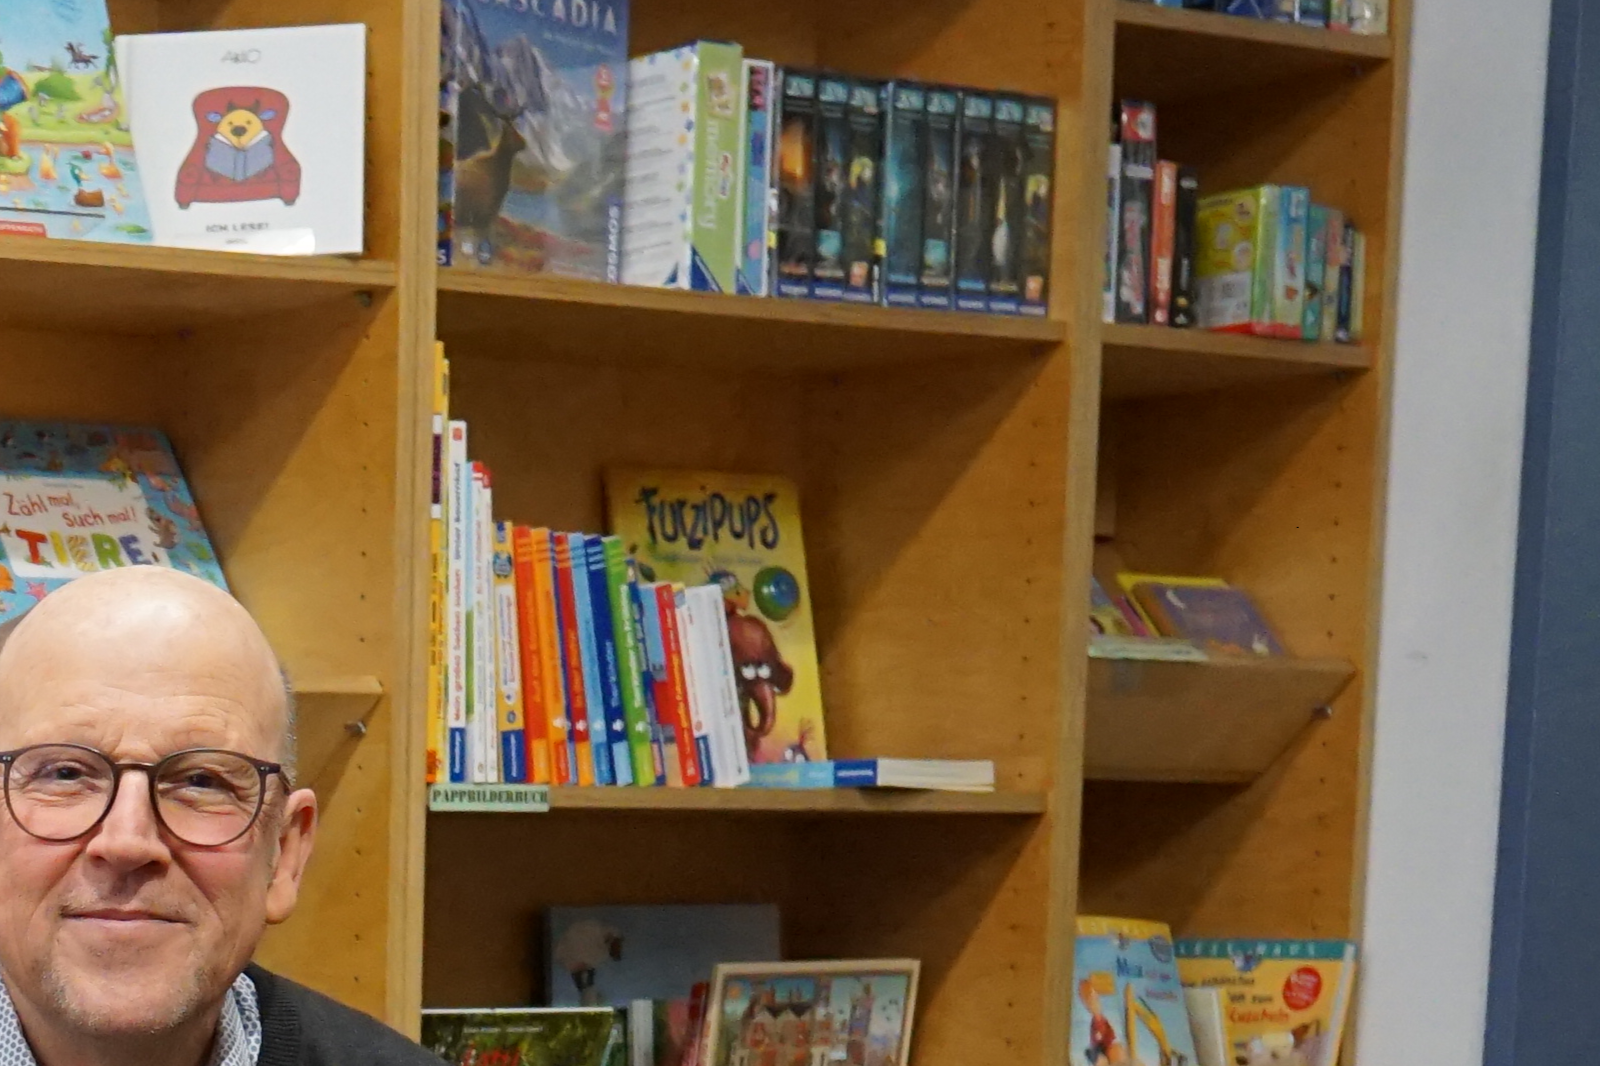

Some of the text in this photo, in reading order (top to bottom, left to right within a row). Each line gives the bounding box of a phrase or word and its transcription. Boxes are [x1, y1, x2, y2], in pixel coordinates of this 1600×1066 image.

[482, 0, 617, 35] SCADIA
[2, 492, 50, 517] Zähl
[61, 507, 139, 528] such mal!
[15, 529, 153, 573] TIERE
